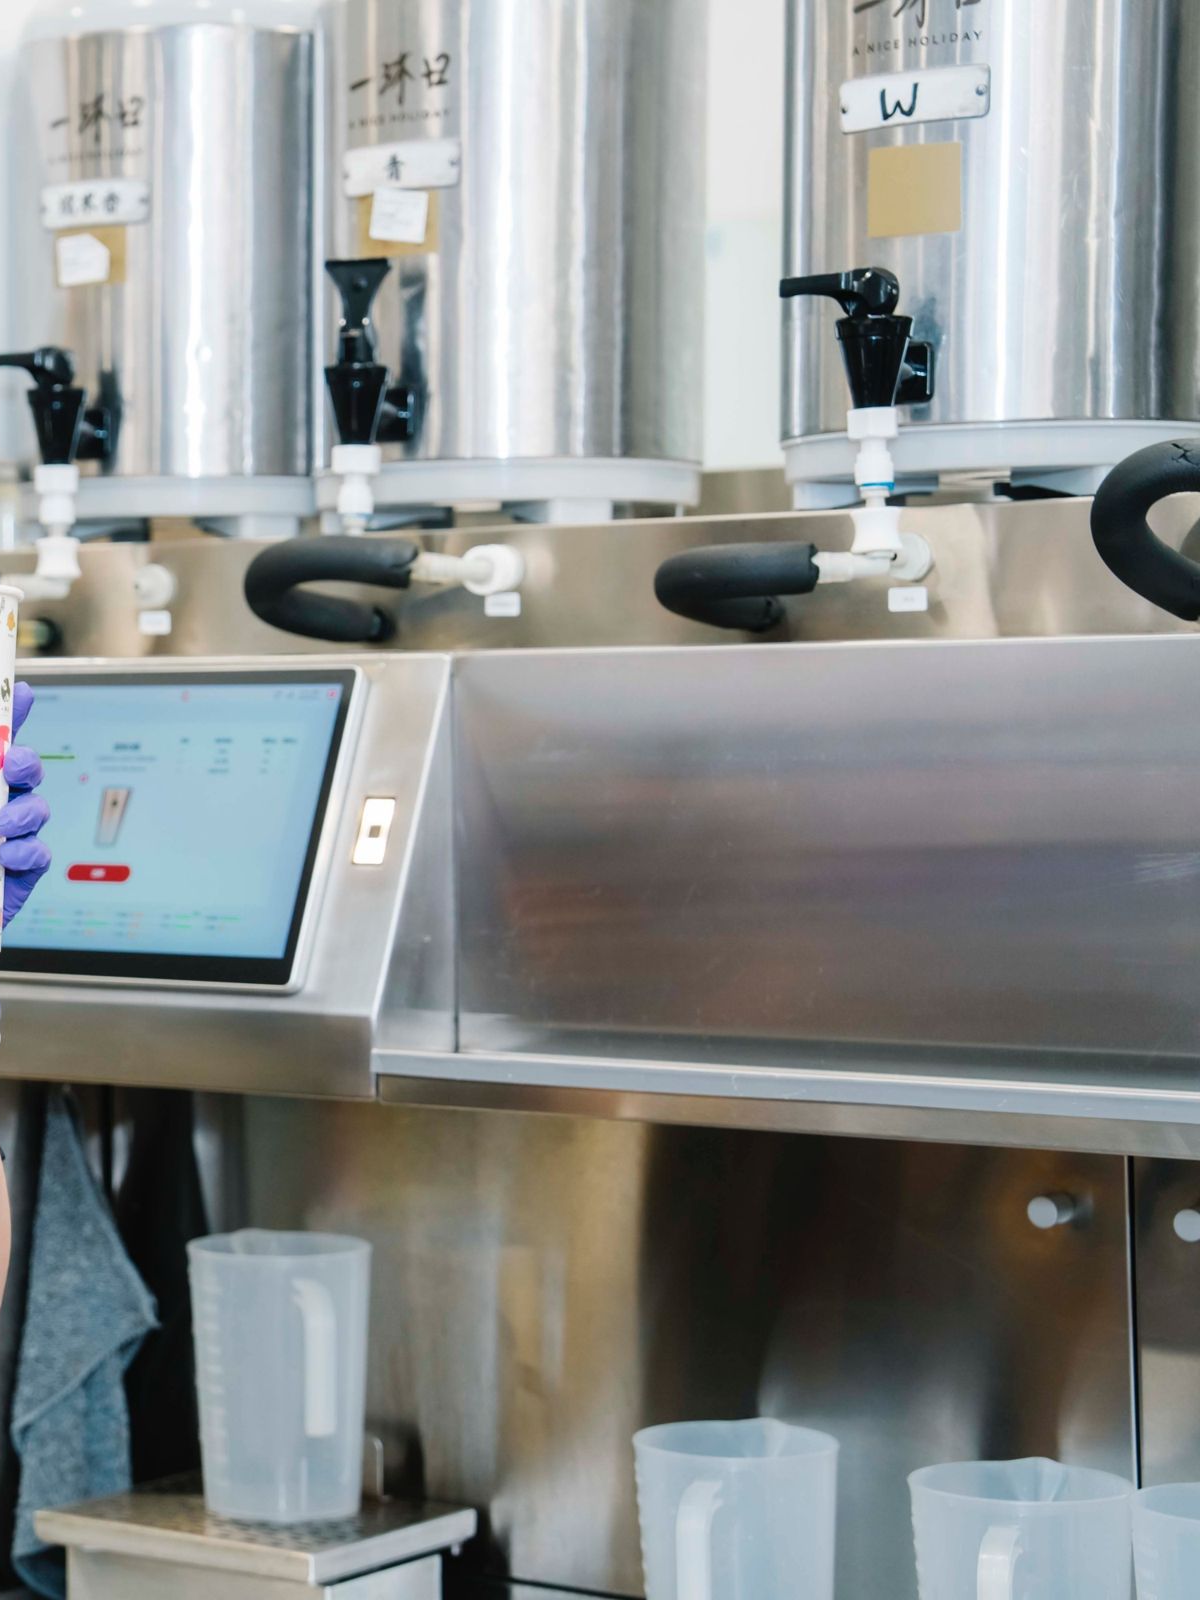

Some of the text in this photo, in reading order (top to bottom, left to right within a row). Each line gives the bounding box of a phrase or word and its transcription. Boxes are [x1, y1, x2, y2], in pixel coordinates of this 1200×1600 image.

[853, 30, 983, 56] A NICE HOLIDAY
[880, 82, 919, 121] W
